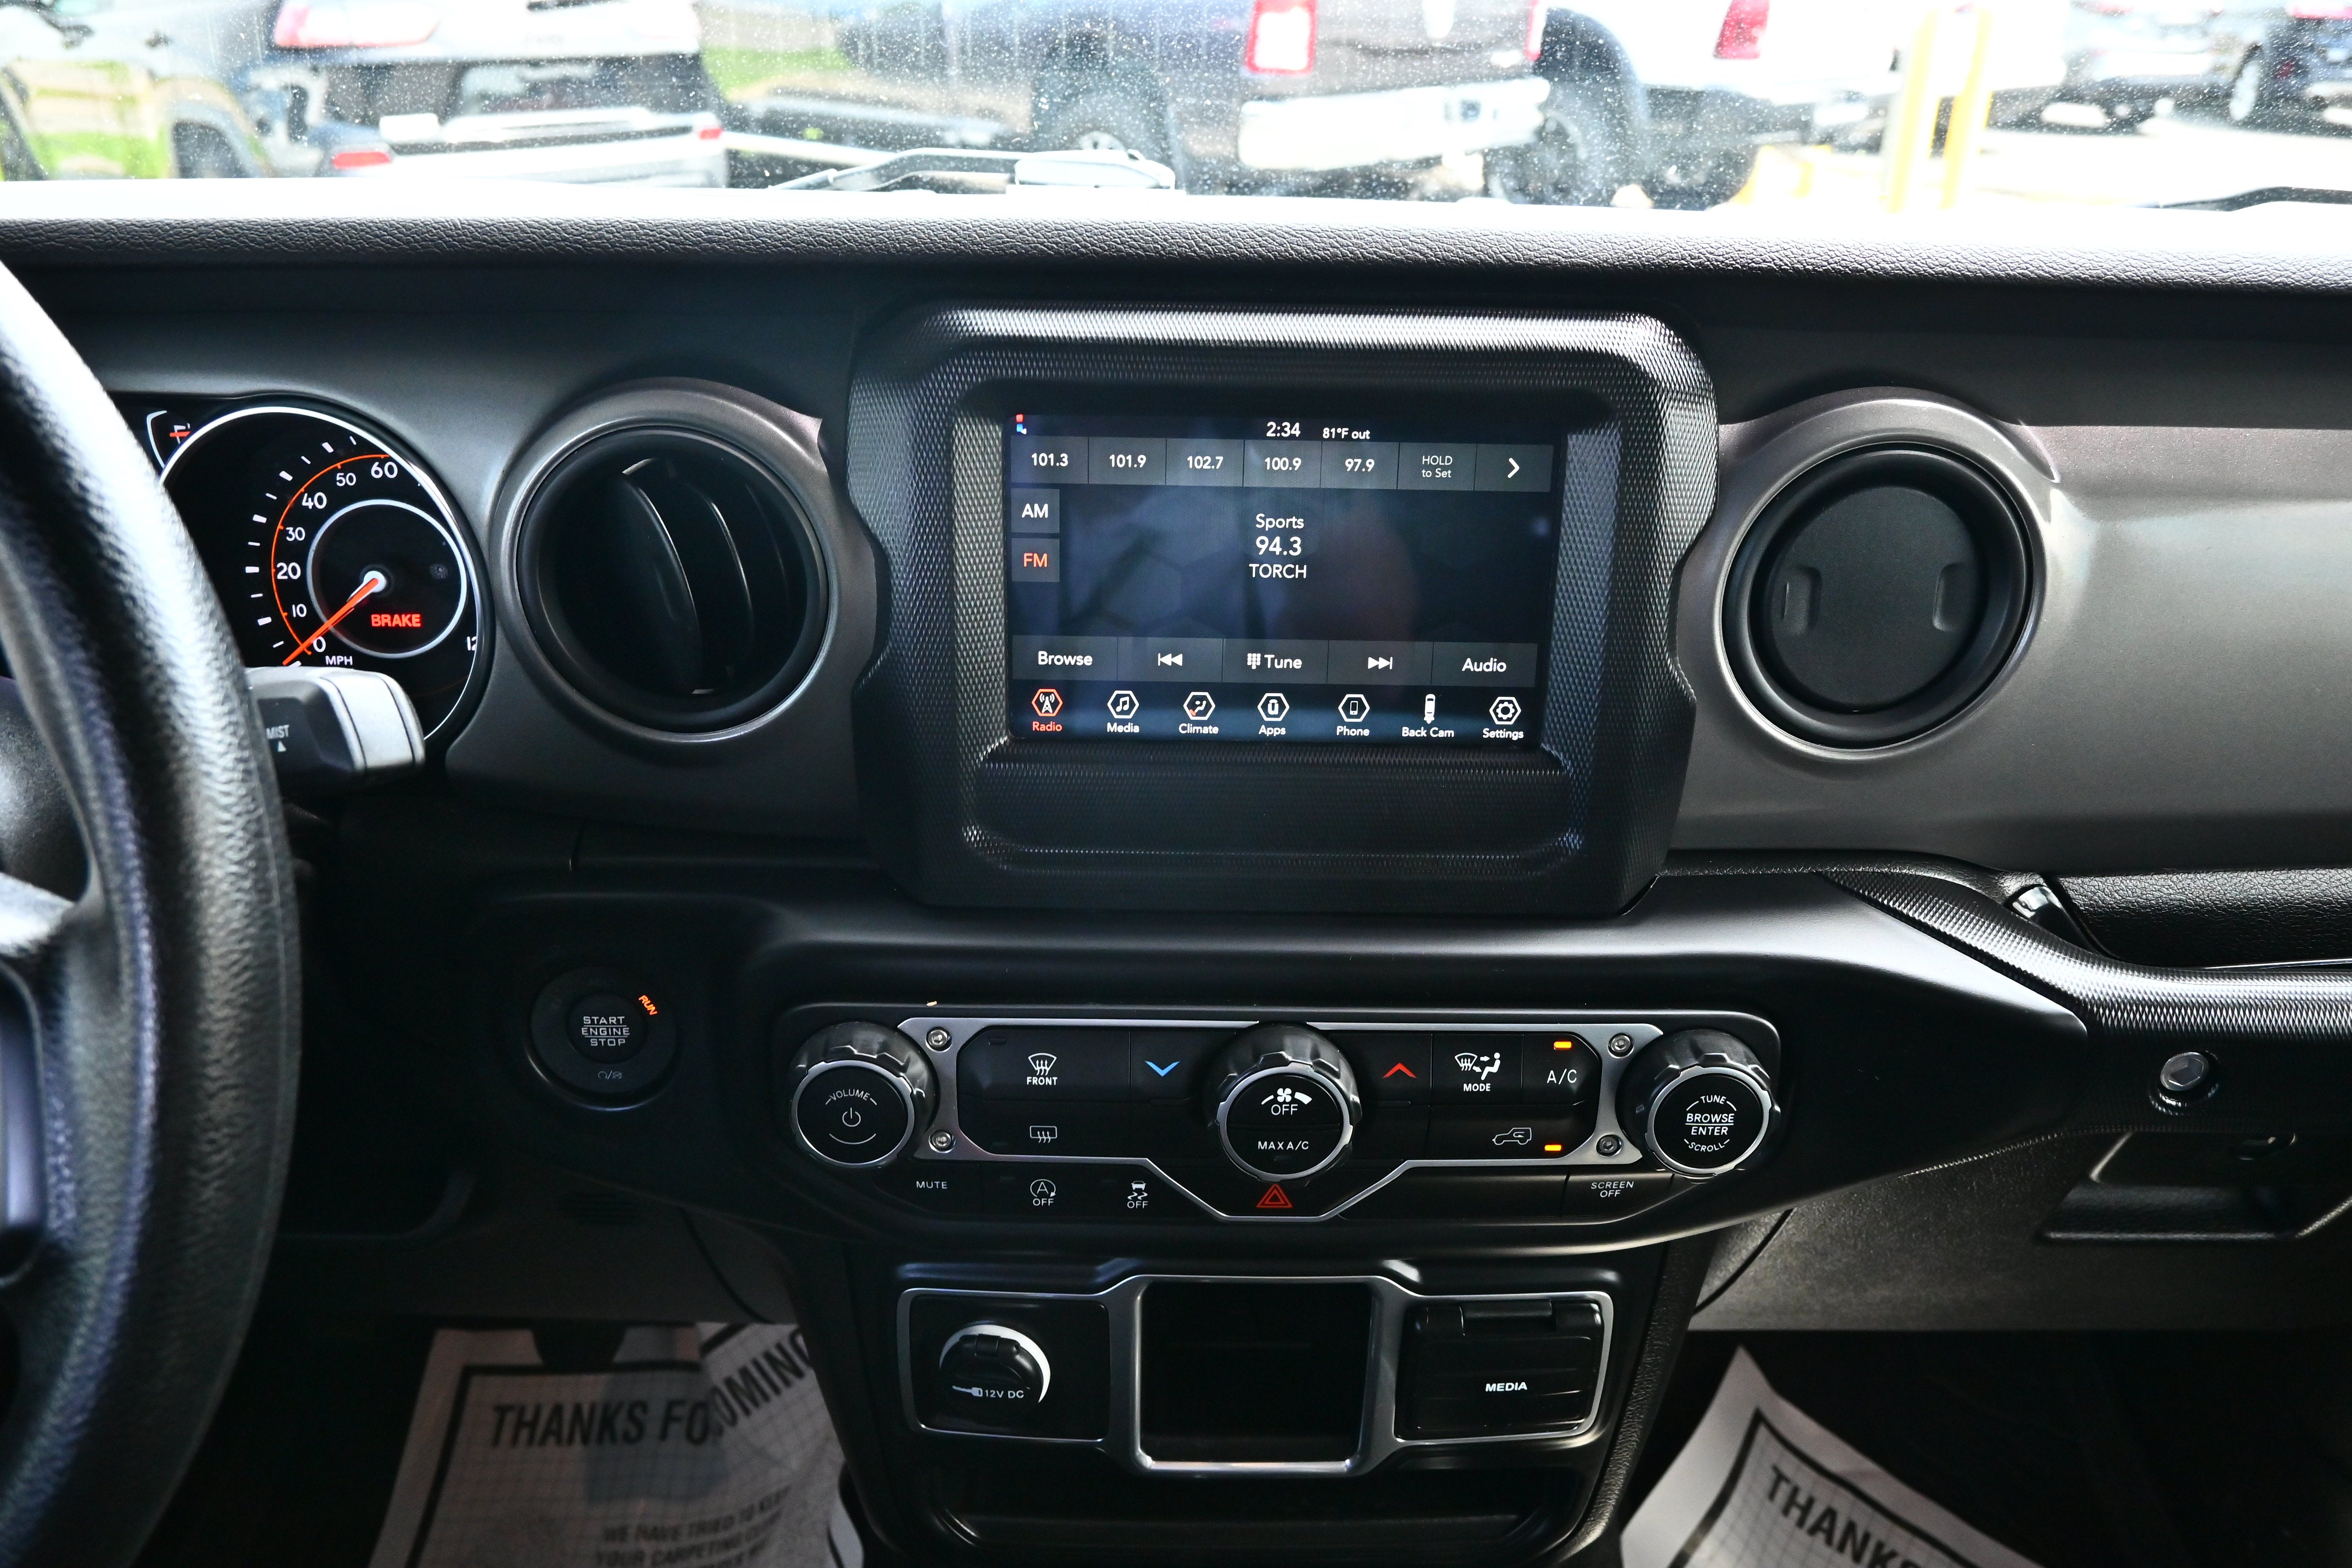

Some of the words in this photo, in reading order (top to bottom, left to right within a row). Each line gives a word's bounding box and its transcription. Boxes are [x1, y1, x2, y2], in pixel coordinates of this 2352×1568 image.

[1266, 421, 1301, 437] 2:34
[1351, 430, 1370, 439] out
[1031, 453, 1068, 467] 101.3
[1109, 454, 1146, 468] 101.9
[1187, 455, 1223, 469] 102.7
[1265, 457, 1301, 471] 100.9
[1345, 458, 1375, 472] 97.9
[1422, 455, 1453, 466] HOLD
[370, 461, 398, 479] 60
[1421, 469, 1432, 478] to
[1435, 468, 1451, 478] Set
[336, 472, 357, 487] 50
[302, 491, 327, 509] 40
[1021, 503, 1048, 518] AM
[1255, 513, 1304, 531] Sports
[286, 527, 305, 542] 30
[1256, 536, 1301, 556] 94.3
[1024, 553, 1048, 567] FM
[277, 562, 301, 580] 20
[1249, 563, 1307, 579] TORCH
[292, 604, 307, 618] 10
[371, 613, 422, 628] BRAKE
[313, 636, 326, 653] 0
[325, 655, 353, 666] MPH
[1038, 651, 1093, 666] Browse
[1264, 654, 1302, 669] Tune
[1462, 657, 1507, 672] Audio
[266, 724, 290, 739] MIST
[1032, 721, 1062, 732] Radio
[1107, 722, 1140, 733] Media
[1179, 723, 1219, 734] Climate
[1258, 724, 1286, 737] Apps
[1337, 725, 1370, 736] Phone
[1402, 726, 1427, 737] Back
[1429, 727, 1454, 738] Cam
[1483, 727, 1524, 740] Settings
[638, 995, 658, 1015] RUN
[583, 1016, 625, 1024] START
[581, 1027, 630, 1035] ENGINE
[590, 1038, 626, 1046] STOP
[1026, 1076, 1058, 1086] FRONT
[1547, 1068, 1577, 1085] A/C
[1463, 1083, 1491, 1092] MODE
[829, 1089, 870, 1101] VOLUME
[1700, 1095, 1726, 1105] TUNE
[1271, 1104, 1298, 1116] OFF
[1686, 1113, 1734, 1123] BROWSE
[1691, 1126, 1728, 1135] ENTER
[1258, 1141, 1284, 1150] MAX
[1286, 1141, 1309, 1150] A/C
[1688, 1142, 1725, 1152] SCROLL
[916, 1181, 947, 1189] MUTE
[1590, 1181, 1634, 1189] SCREEN
[1600, 1190, 1621, 1198] OFF
[1032, 1198, 1054, 1206] OFF
[1127, 1200, 1148, 1209] OFF
[709, 1328, 812, 1436] OMIN
[1485, 1382, 1527, 1392] MEDIA
[985, 1390, 1004, 1398] 12V
[1007, 1390, 1024, 1399] DC
[491, 1402, 648, 1447] THANKS
[659, 1398, 711, 1445] FO
